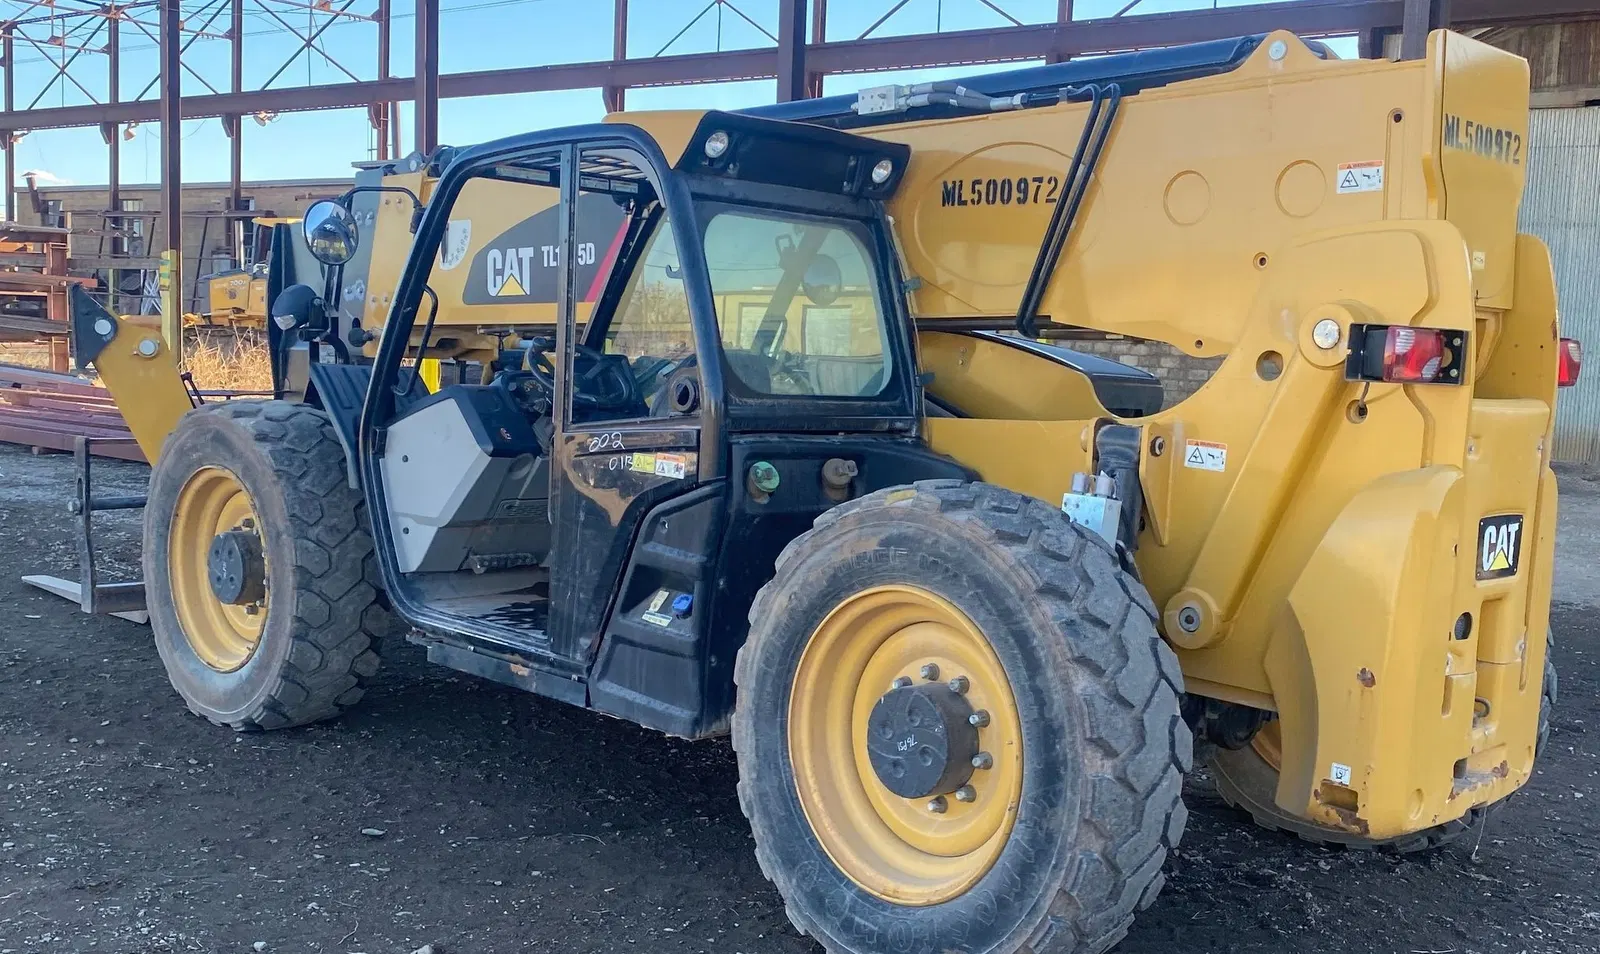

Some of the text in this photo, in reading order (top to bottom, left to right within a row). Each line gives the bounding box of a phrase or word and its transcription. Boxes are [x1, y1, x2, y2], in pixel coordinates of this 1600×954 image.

[1444, 113, 1521, 165] ML500972
[941, 176, 1060, 207] ML500972
[486, 246, 535, 298] CAT
[1482, 522, 1520, 572] CAT
